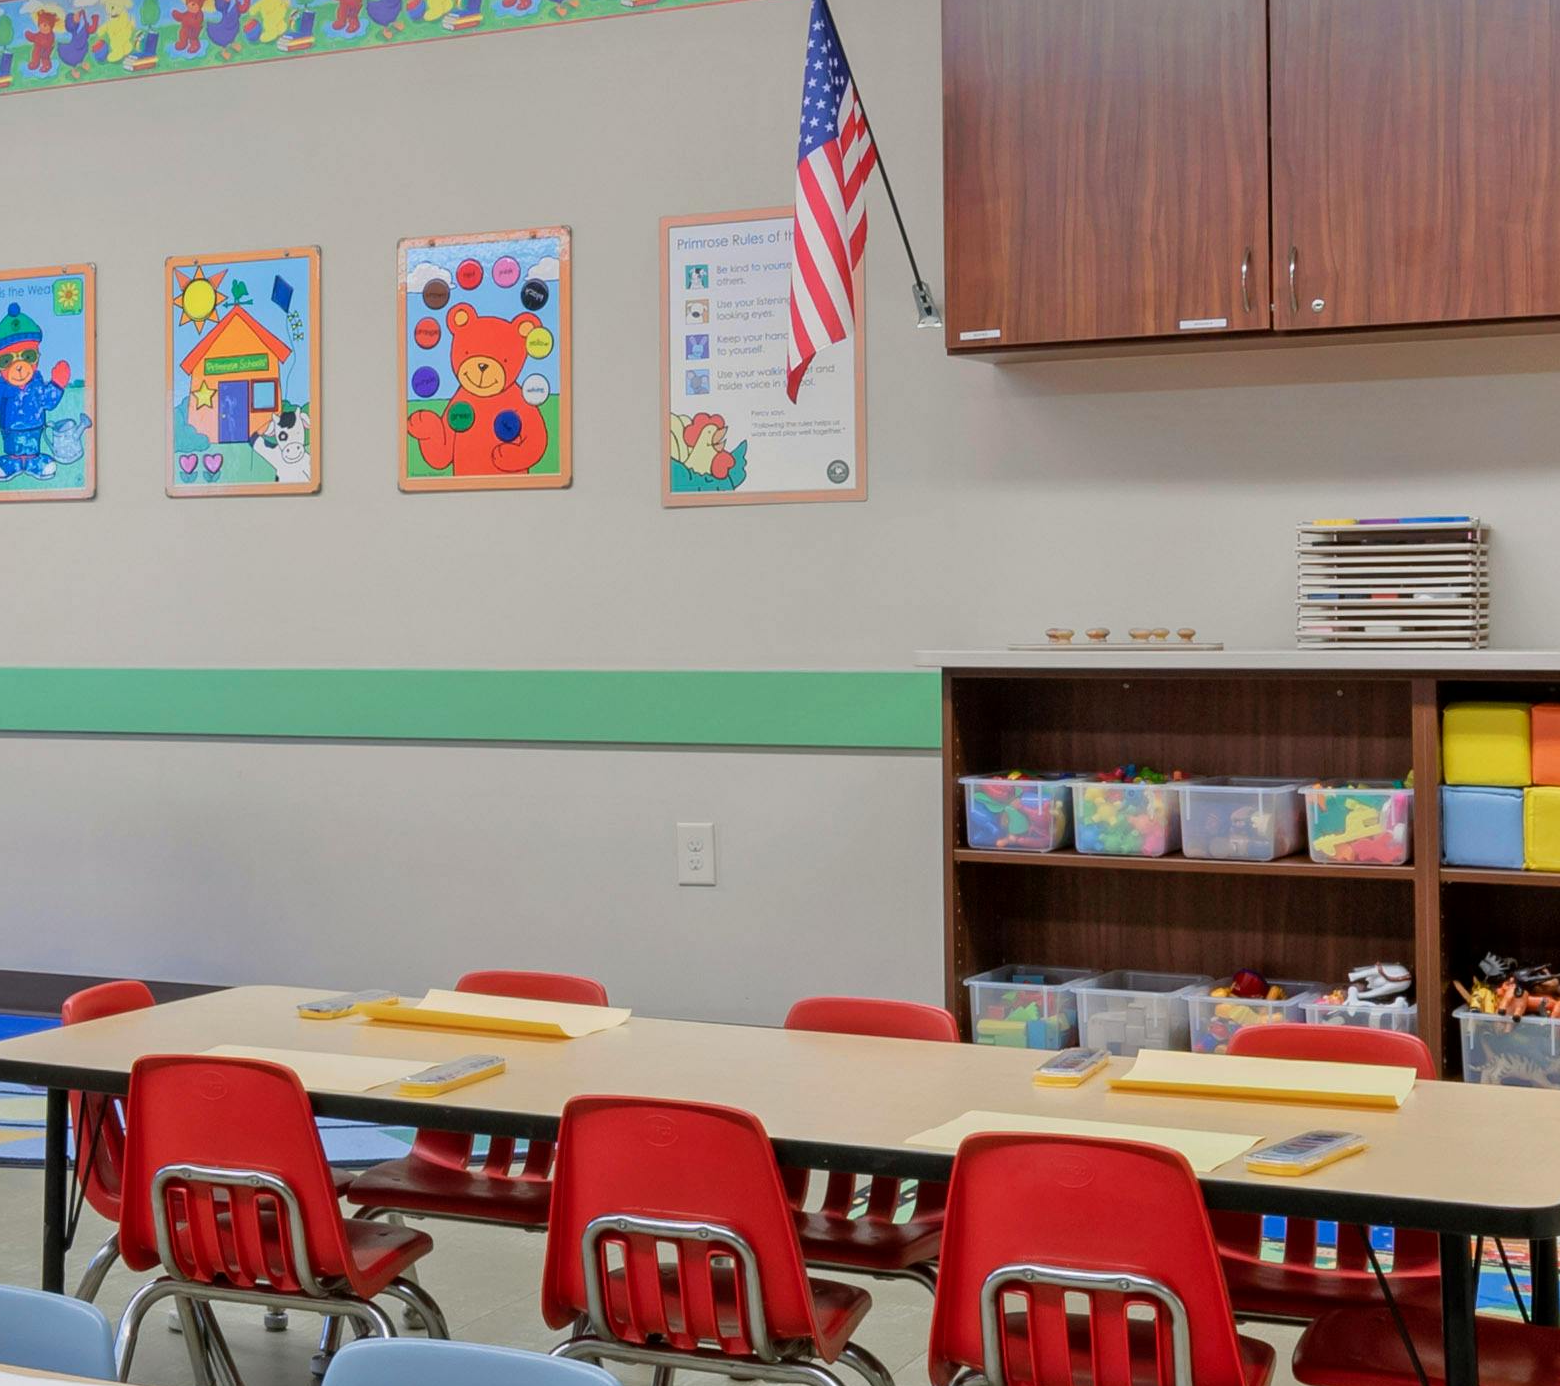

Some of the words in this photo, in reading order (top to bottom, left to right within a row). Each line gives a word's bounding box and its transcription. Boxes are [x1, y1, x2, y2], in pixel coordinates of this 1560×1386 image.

[677, 237, 729, 251] Primrose
[732, 233, 764, 246] Rules
[767, 230, 780, 243] of
[716, 266, 727, 274] Be
[730, 264, 749, 273] kind
[751, 263, 760, 271] to
[8, 287, 24, 296] the
[716, 300, 732, 308] Use
[734, 298, 754, 309] your
[716, 311, 749, 321] looking
[751, 310, 775, 320] eyes.
[717, 336, 741, 344] Keep
[743, 334, 763, 343] your
[717, 348, 726, 356] to
[717, 370, 733, 379] Use
[736, 370, 755, 379] your
[816, 364, 835, 374] and
[717, 381, 743, 390] inside
[745, 380, 770, 389] voice
[772, 380, 781, 388] in
[783, 430, 797, 438] play
[798, 428, 812, 436] well
